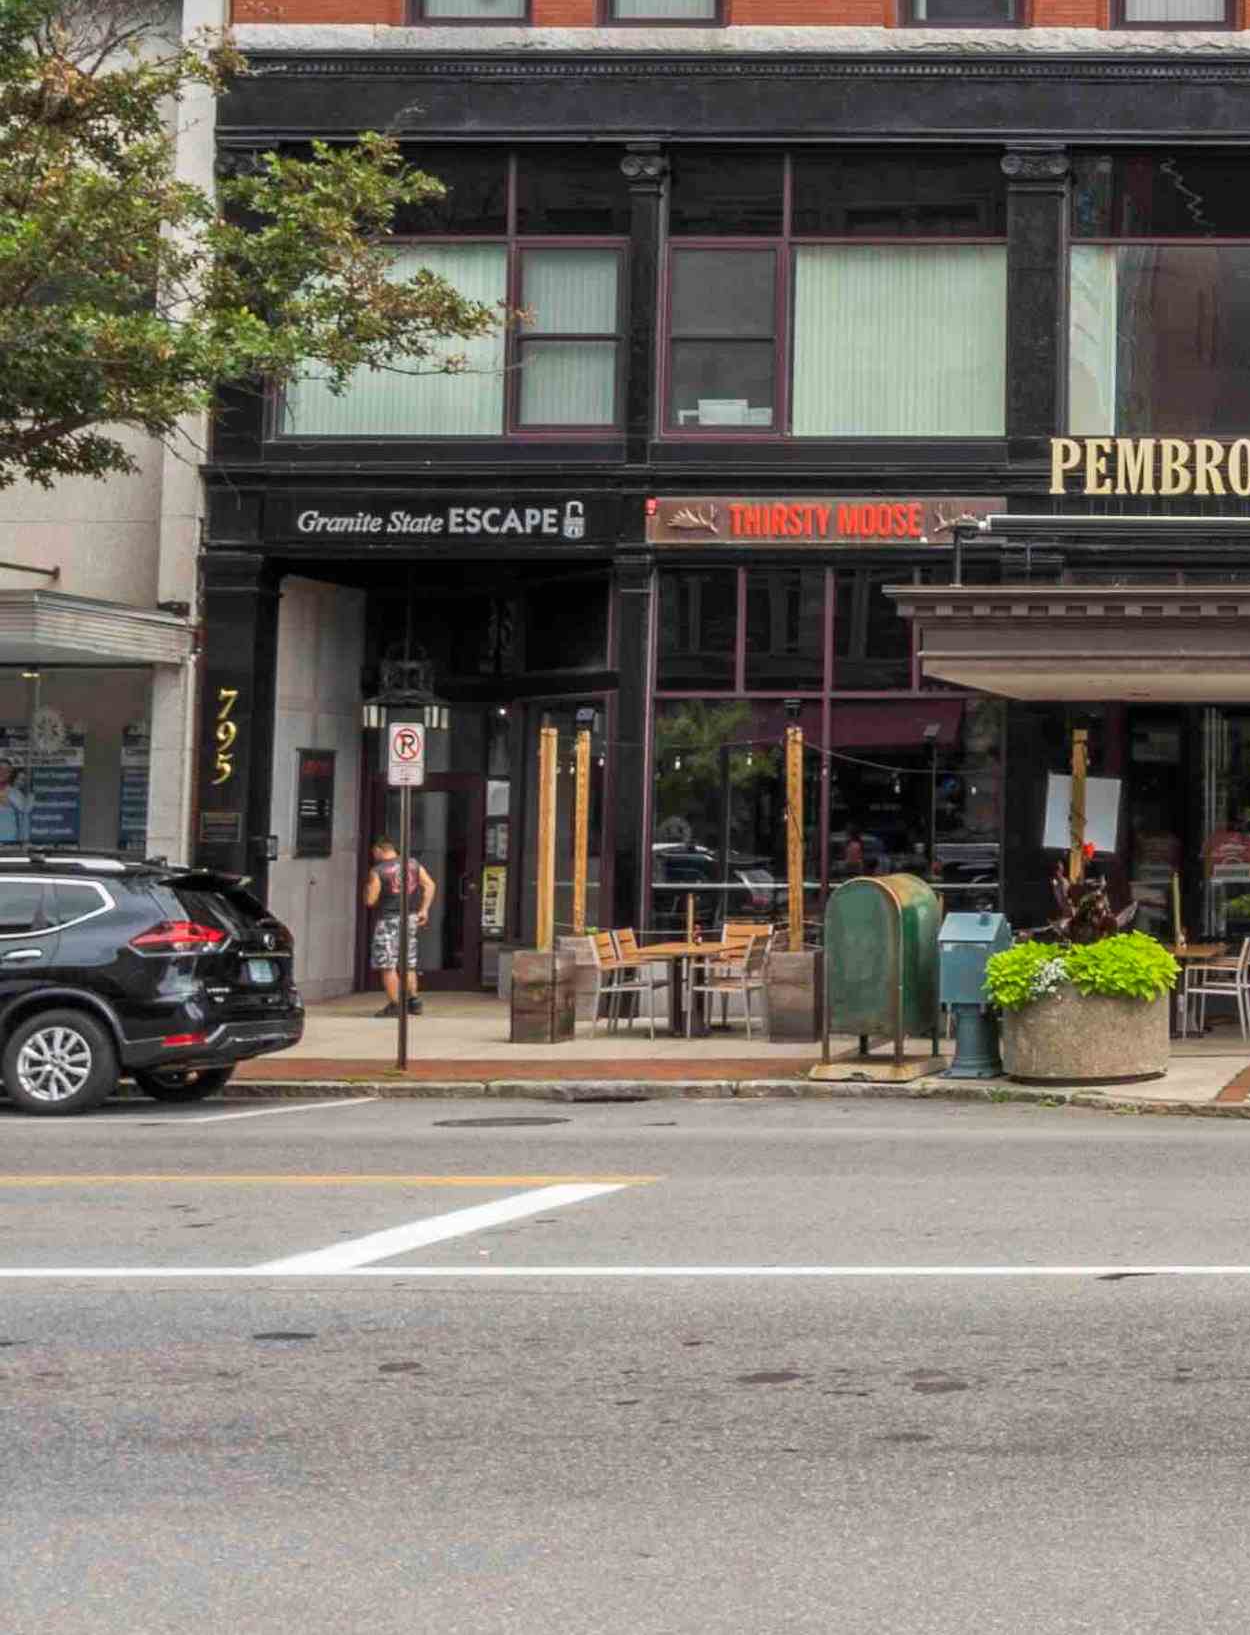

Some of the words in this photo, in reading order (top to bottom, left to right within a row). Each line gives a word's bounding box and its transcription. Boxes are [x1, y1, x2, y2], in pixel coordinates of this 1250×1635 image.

[297, 510, 382, 533] Granite
[386, 511, 443, 533] State
[448, 507, 559, 534] ESCAPE
[729, 503, 829, 536] THIRSTY
[837, 503, 923, 537] MOOSE
[210, 688, 239, 785] 795
